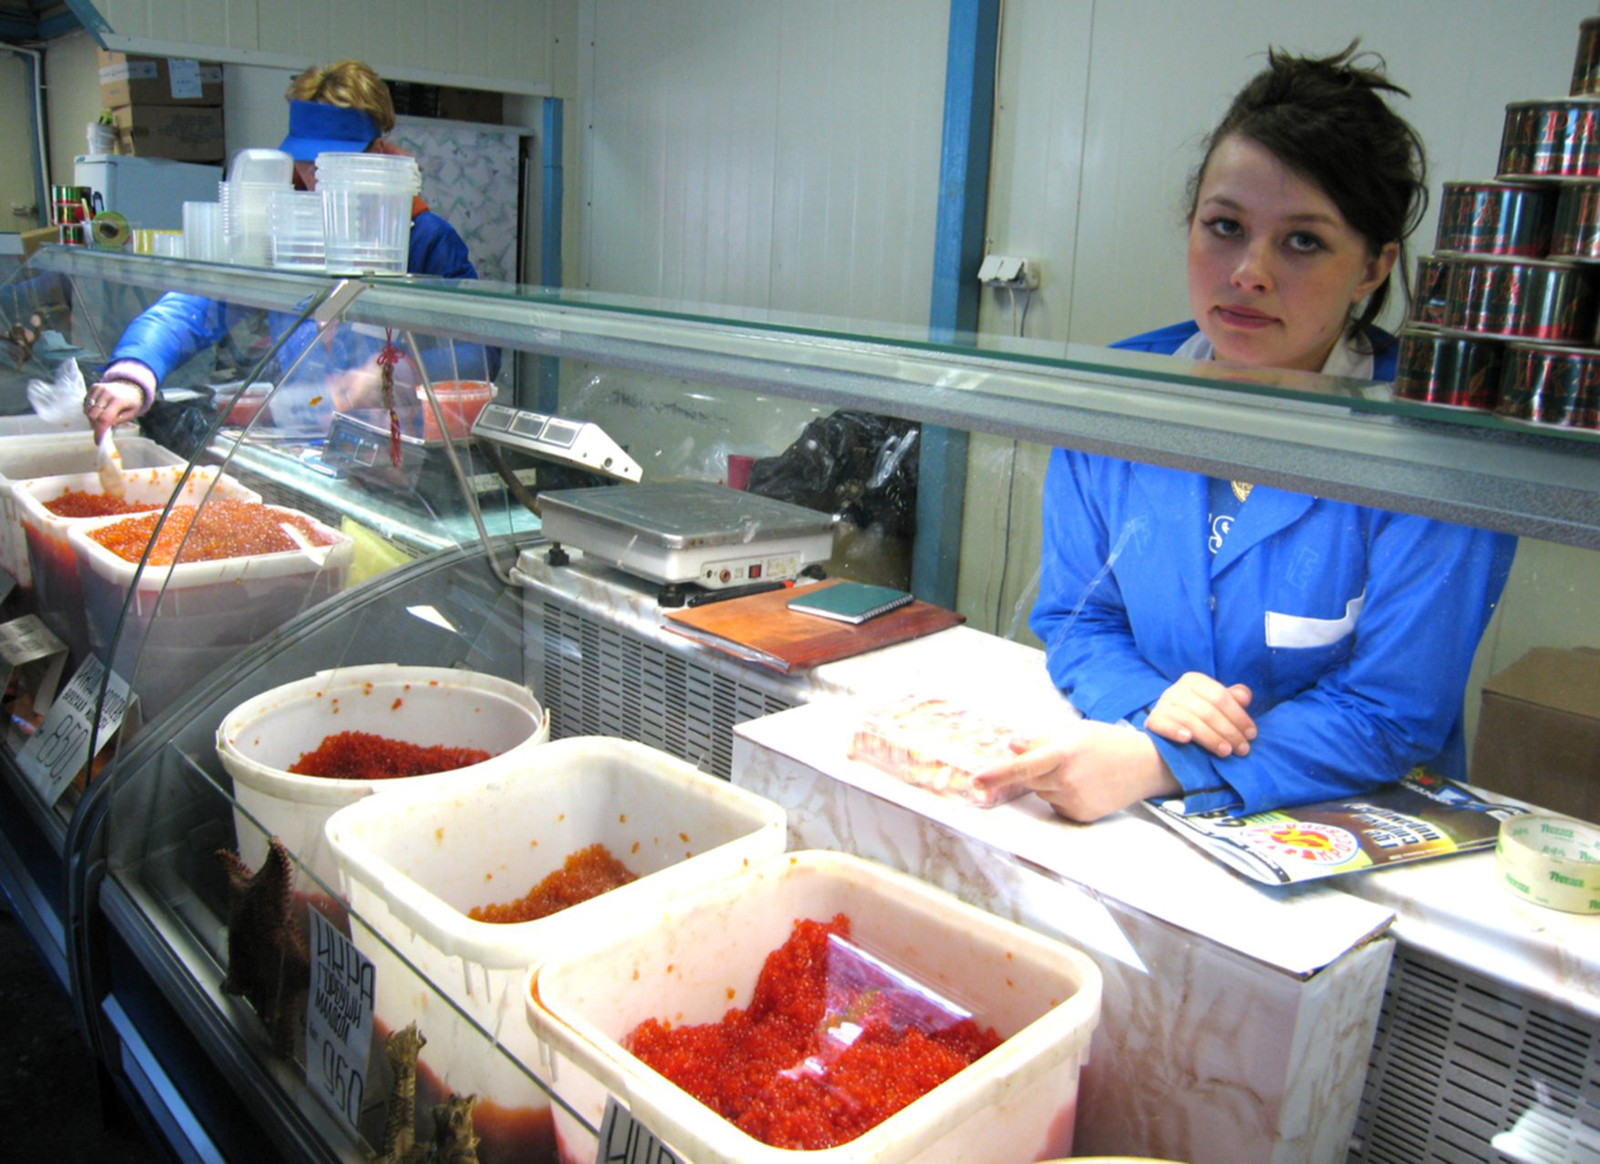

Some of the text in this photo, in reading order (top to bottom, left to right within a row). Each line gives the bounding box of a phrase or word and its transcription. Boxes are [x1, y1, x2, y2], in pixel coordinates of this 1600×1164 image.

[1516, 356, 1600, 397] ИКР
[315, 914, 375, 1010] ИКРА
[322, 1039, 364, 1133] 950
